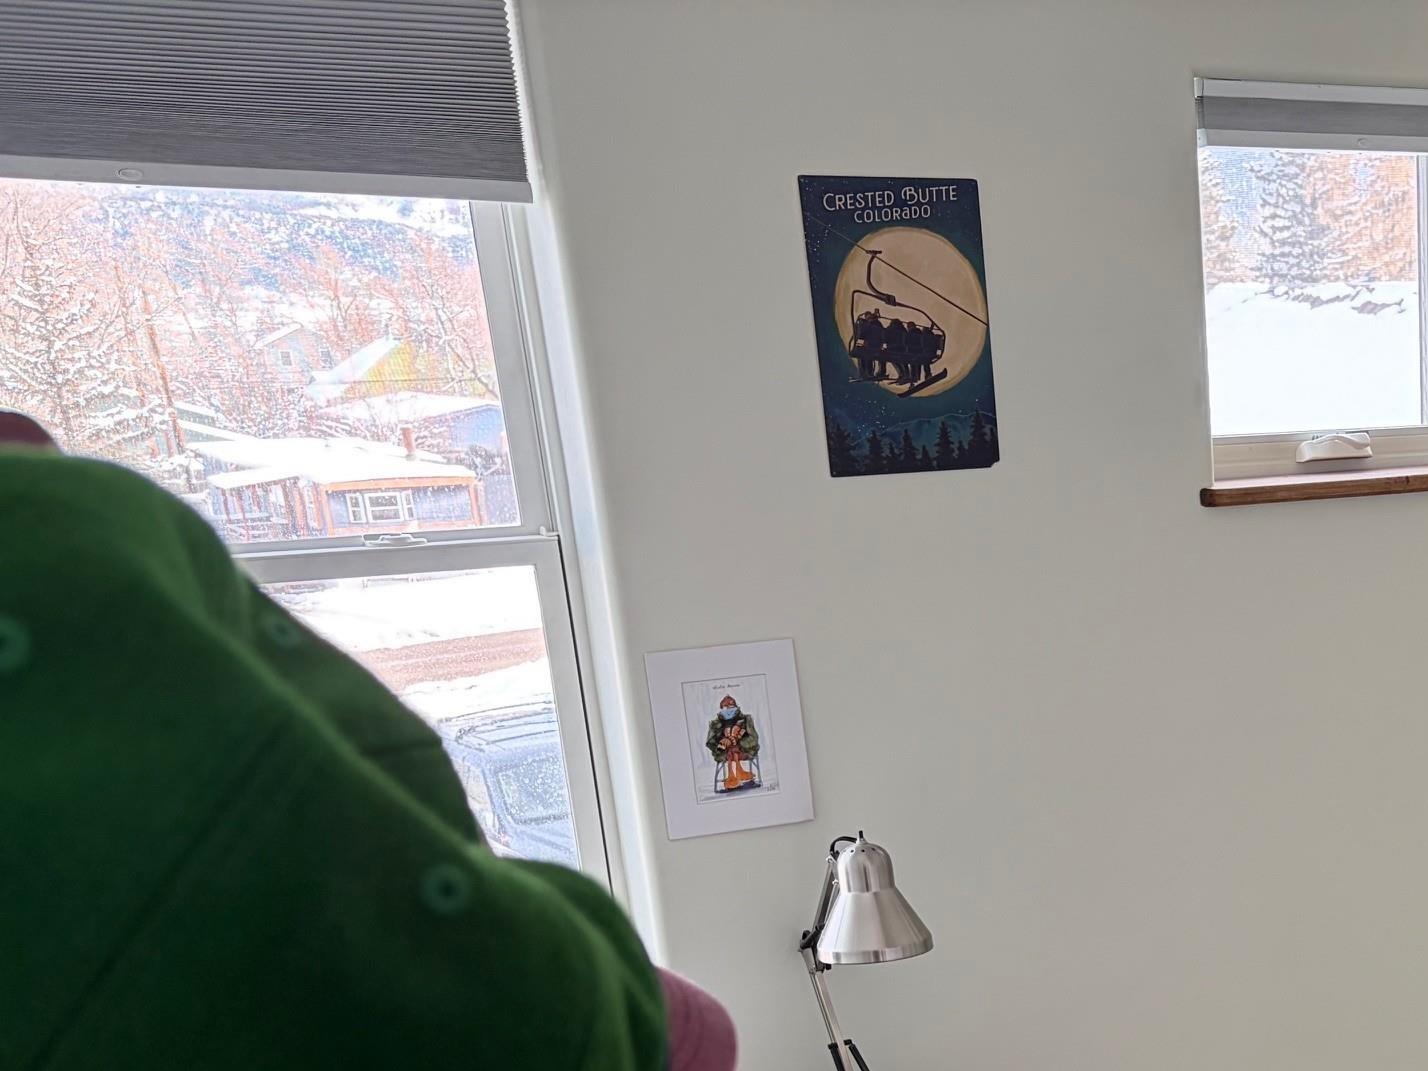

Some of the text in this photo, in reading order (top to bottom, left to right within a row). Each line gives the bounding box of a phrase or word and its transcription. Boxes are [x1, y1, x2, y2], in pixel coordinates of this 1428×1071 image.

[823, 185, 958, 211] CRESTED BUTTE
[854, 205, 931, 223] COLORADO
